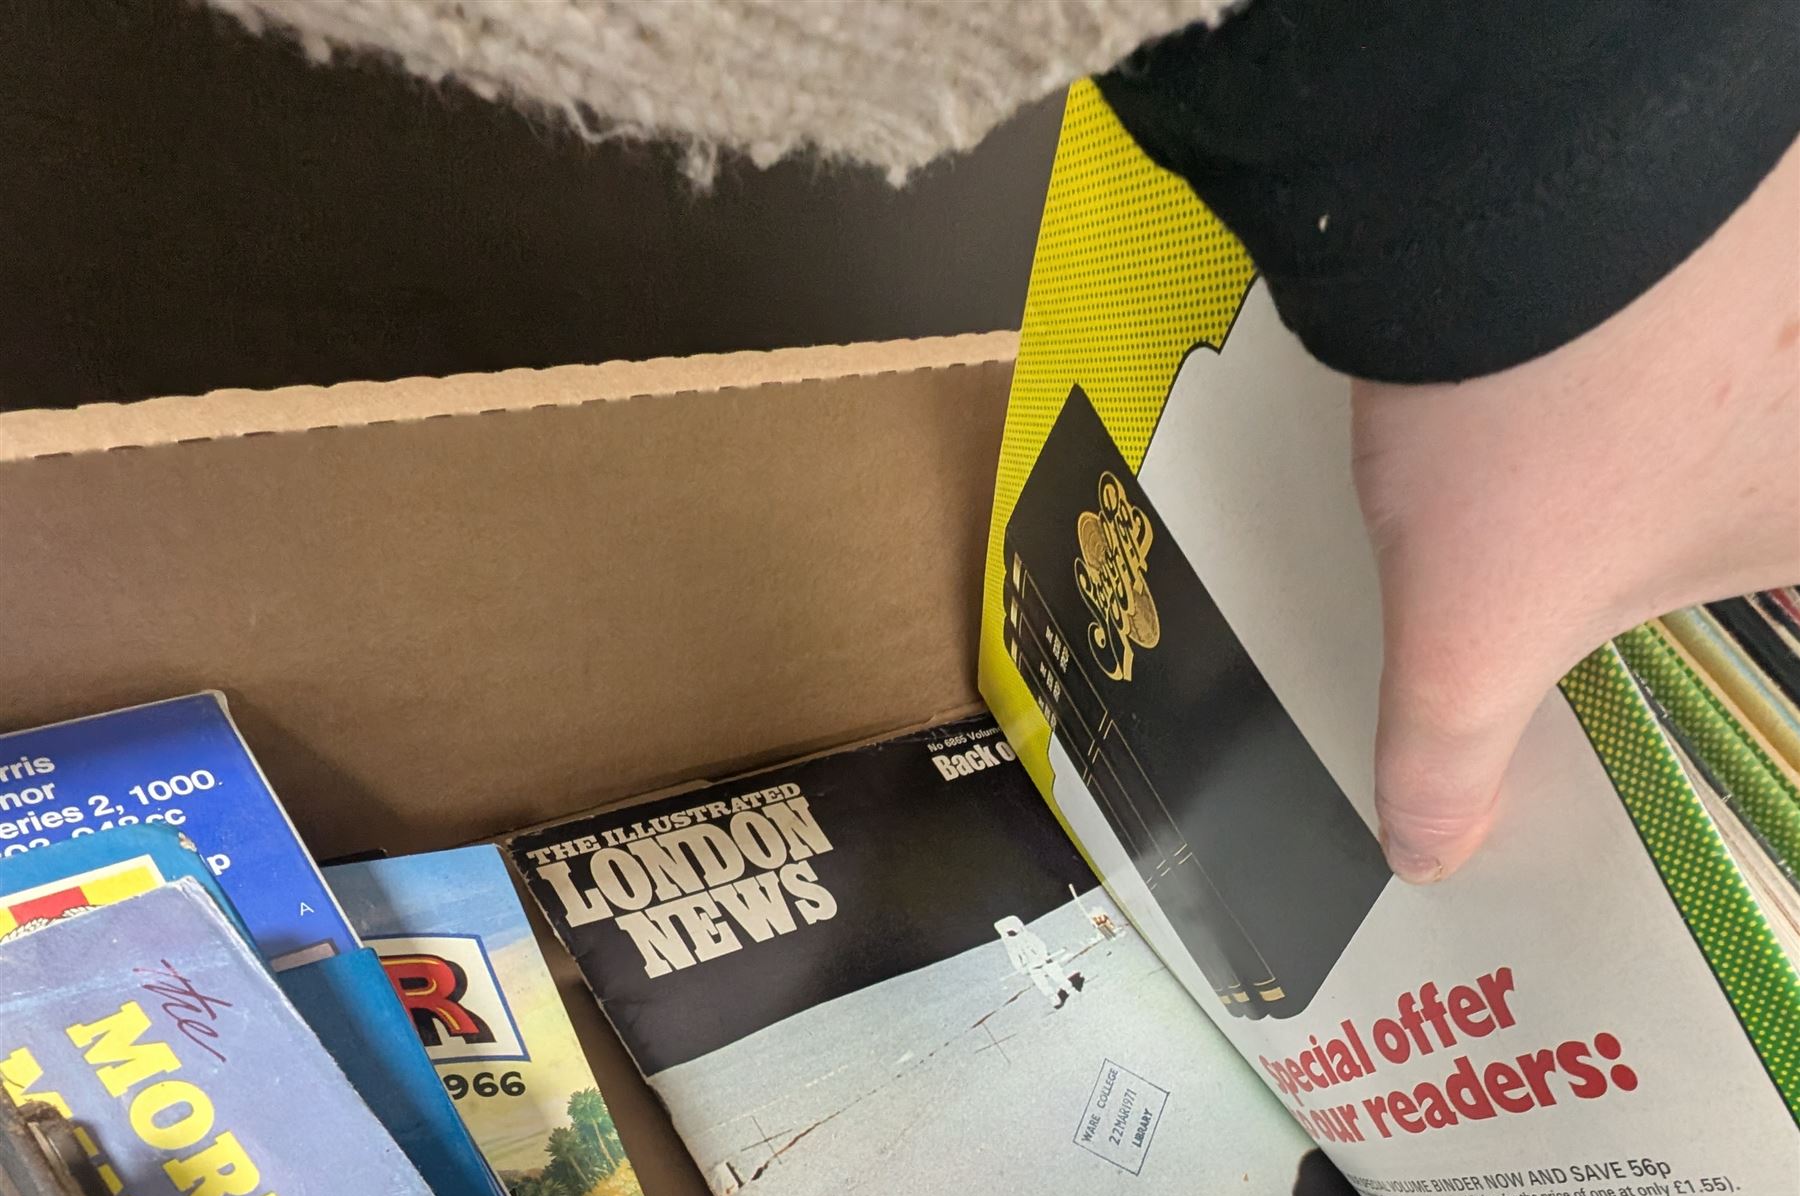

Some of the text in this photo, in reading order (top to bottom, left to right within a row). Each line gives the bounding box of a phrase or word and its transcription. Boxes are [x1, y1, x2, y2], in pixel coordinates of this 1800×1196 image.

[0, 756, 55, 782] rris
[927, 744, 943, 752] No
[932, 744, 1000, 781] Back
[0, 806, 84, 839] eries
[88, 795, 125, 817] 2,
[528, 783, 802, 867] THE ILLUSTRATED
[537, 797, 834, 928] LONDON
[300, 902, 314, 916] A
[615, 861, 837, 979] NEWS
[1259, 966, 1518, 1107] Special offer
[1081, 1068, 1118, 1142] WARE COLLEGE
[1310, 1104, 1365, 1143] our
[1361, 1031, 1639, 1140] readers:
[1132, 1108, 1153, 1148] LIBRARY
[1389, 1180, 1432, 1193] VOLUME
[1430, 1176, 1484, 1192] BINDER
[1483, 1172, 1524, 1189] NOW
[1528, 1167, 1567, 1186] AND
[1570, 1161, 1626, 1182] SAVE
[1627, 1158, 1671, 1179] 56p
